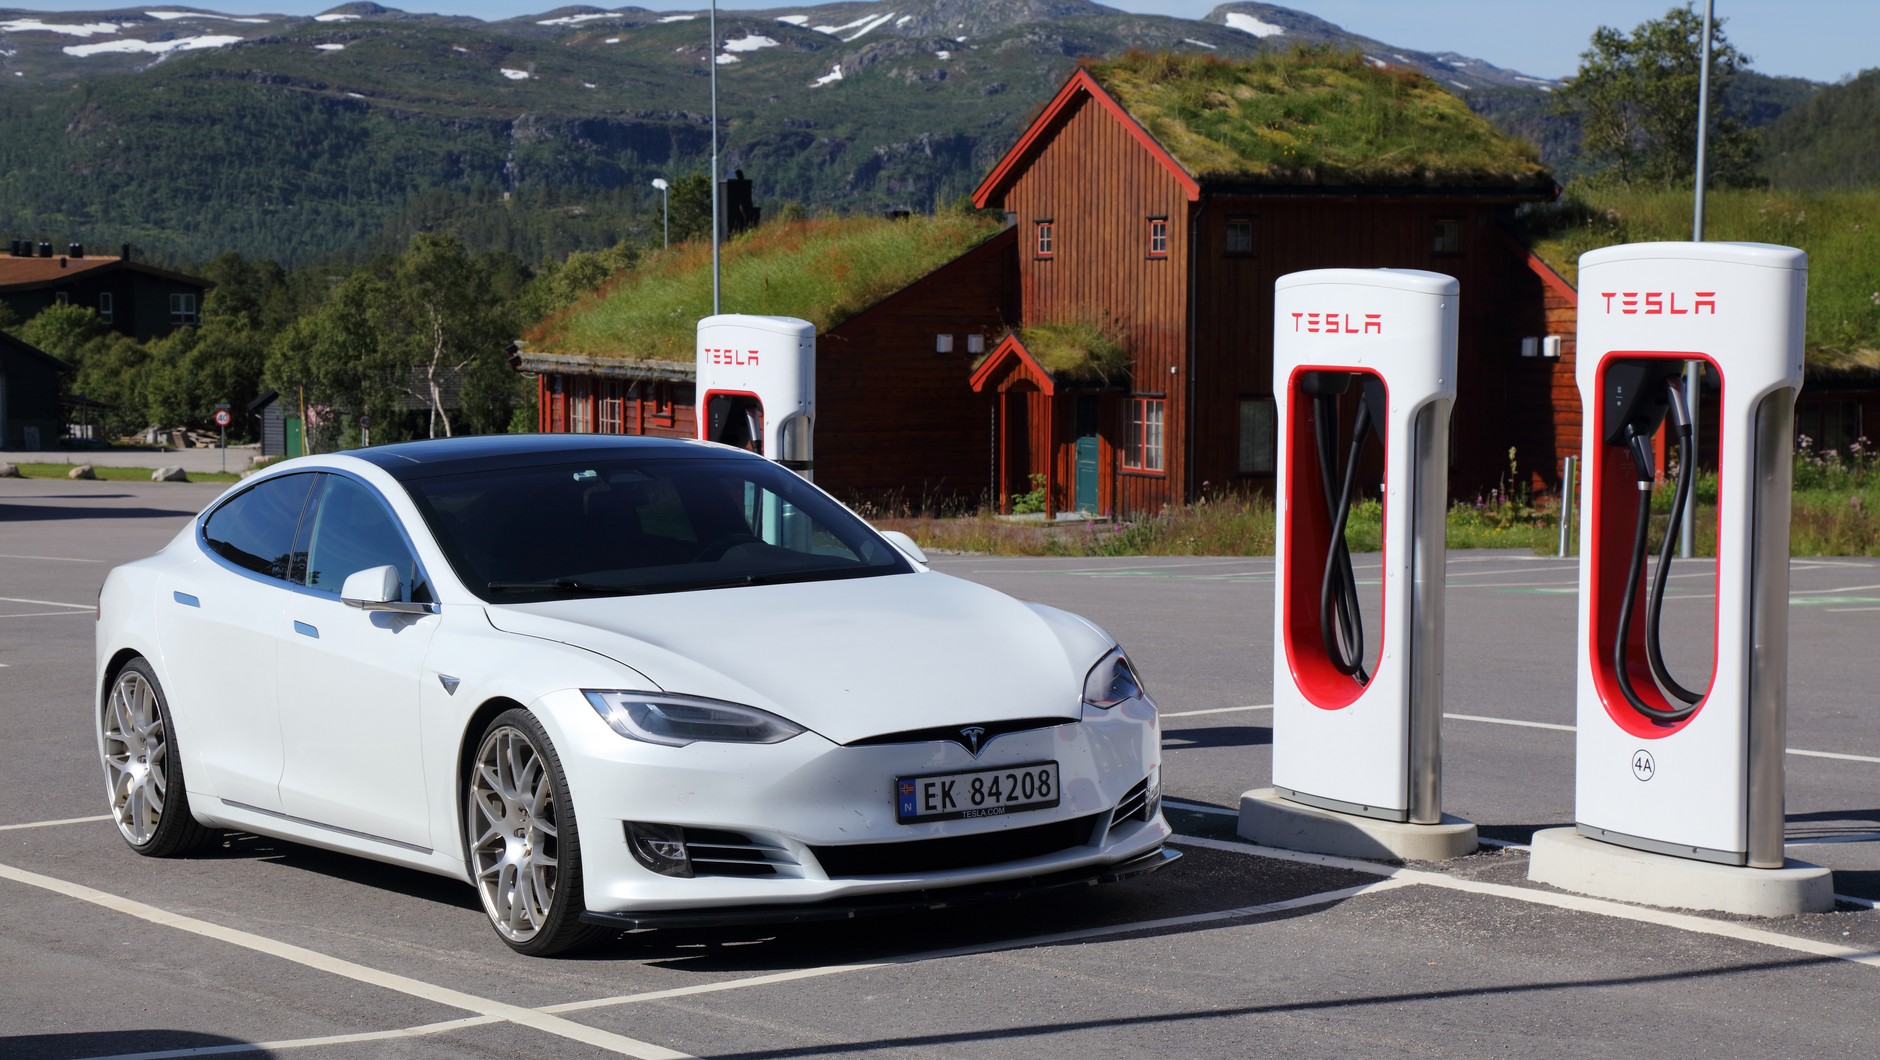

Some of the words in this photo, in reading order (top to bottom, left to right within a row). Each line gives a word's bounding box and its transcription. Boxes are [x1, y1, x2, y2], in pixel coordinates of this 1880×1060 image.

[1601, 292, 1716, 315] TESLA
[1291, 312, 1382, 334] TESLA
[704, 348, 759, 366] TESLA
[1635, 757, 1652, 773] 4A
[904, 802, 912, 812] N
[923, 780, 957, 811] EK
[970, 769, 1051, 806] 84208
[962, 807, 1005, 819] TESLA.COM
